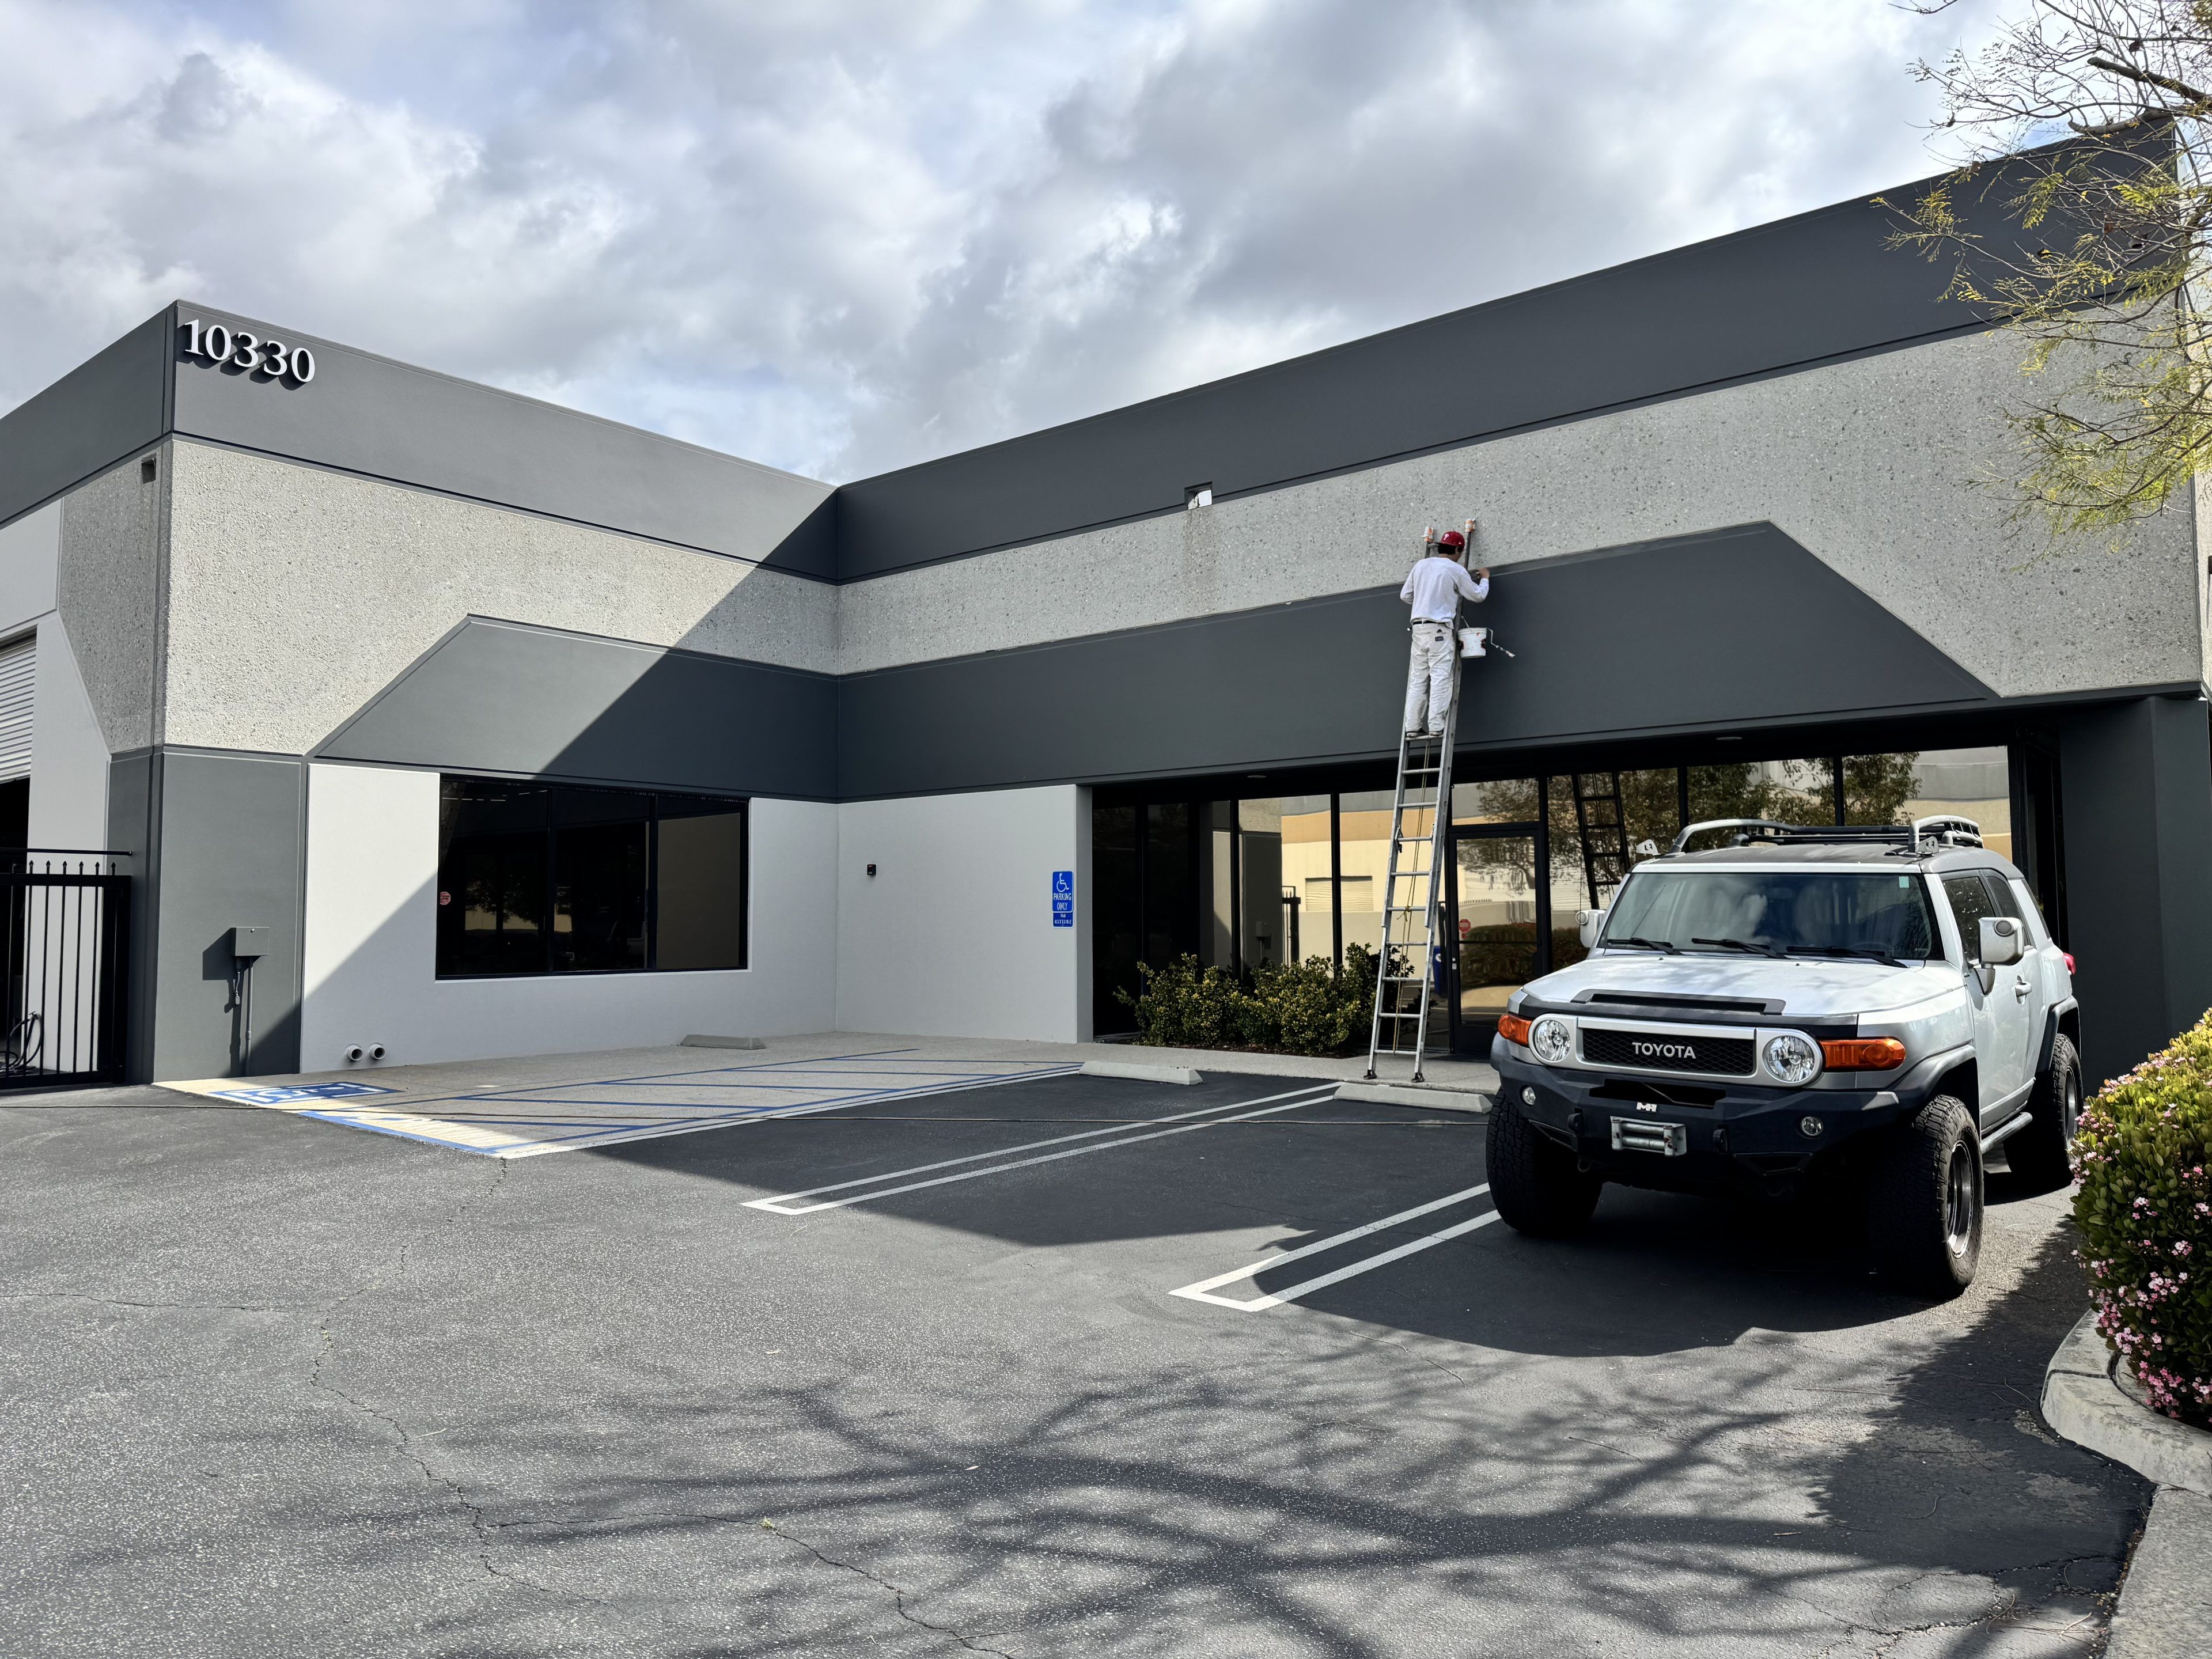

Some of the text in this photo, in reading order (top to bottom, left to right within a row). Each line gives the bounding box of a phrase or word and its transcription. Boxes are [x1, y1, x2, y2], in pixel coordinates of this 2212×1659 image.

[184, 319, 316, 382] 10330
[1054, 893, 1071, 901] PARKING
[1057, 902, 1067, 910] ONLY
[1632, 1041, 1696, 1059] TOYOTA
